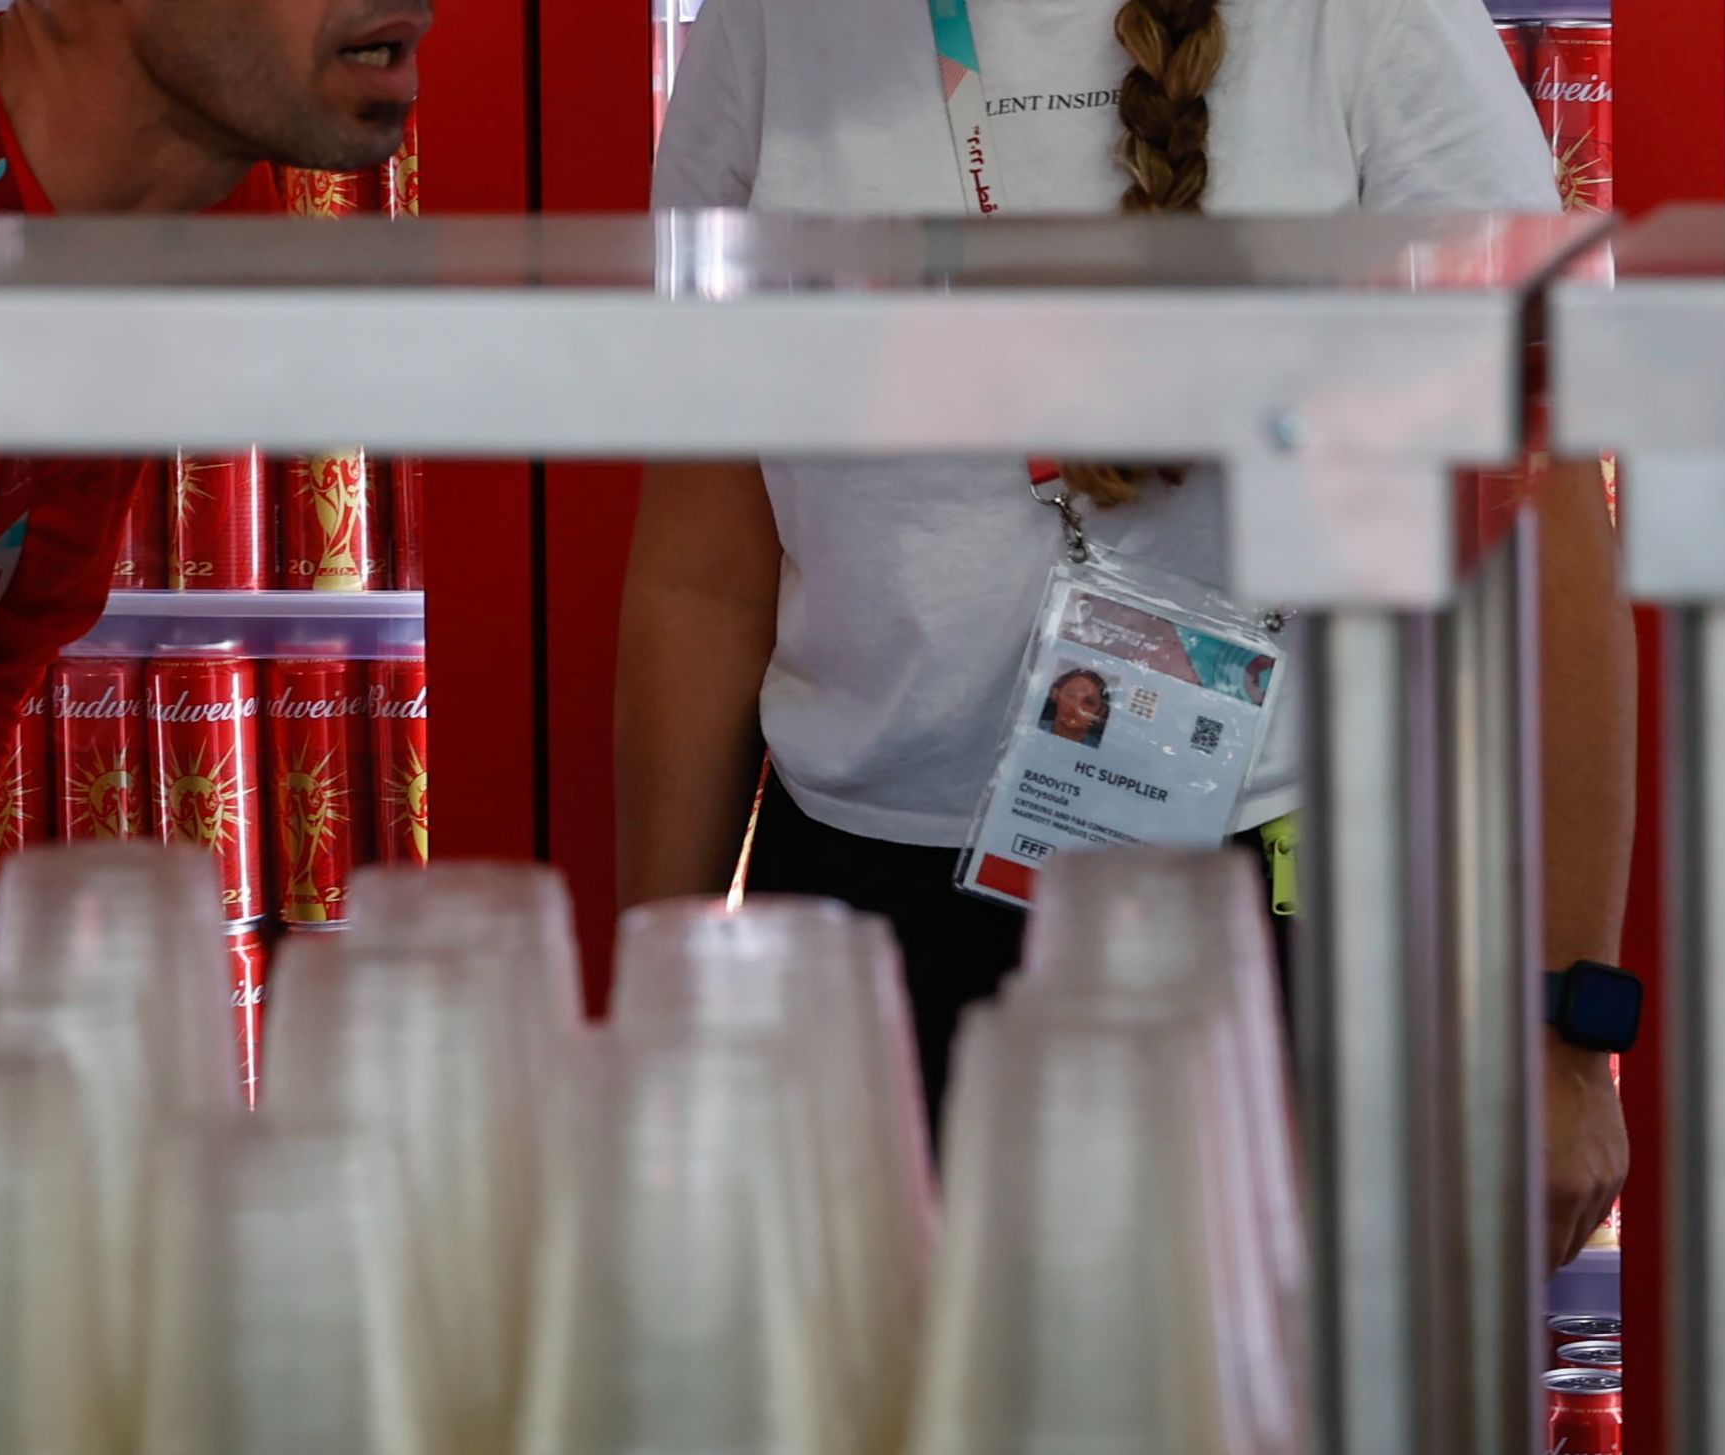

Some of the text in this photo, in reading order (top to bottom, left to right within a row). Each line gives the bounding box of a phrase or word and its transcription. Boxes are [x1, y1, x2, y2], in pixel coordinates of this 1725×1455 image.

[1074, 760, 1169, 803] HC SUPPLIER
[1019, 839, 1048, 858] FFF
